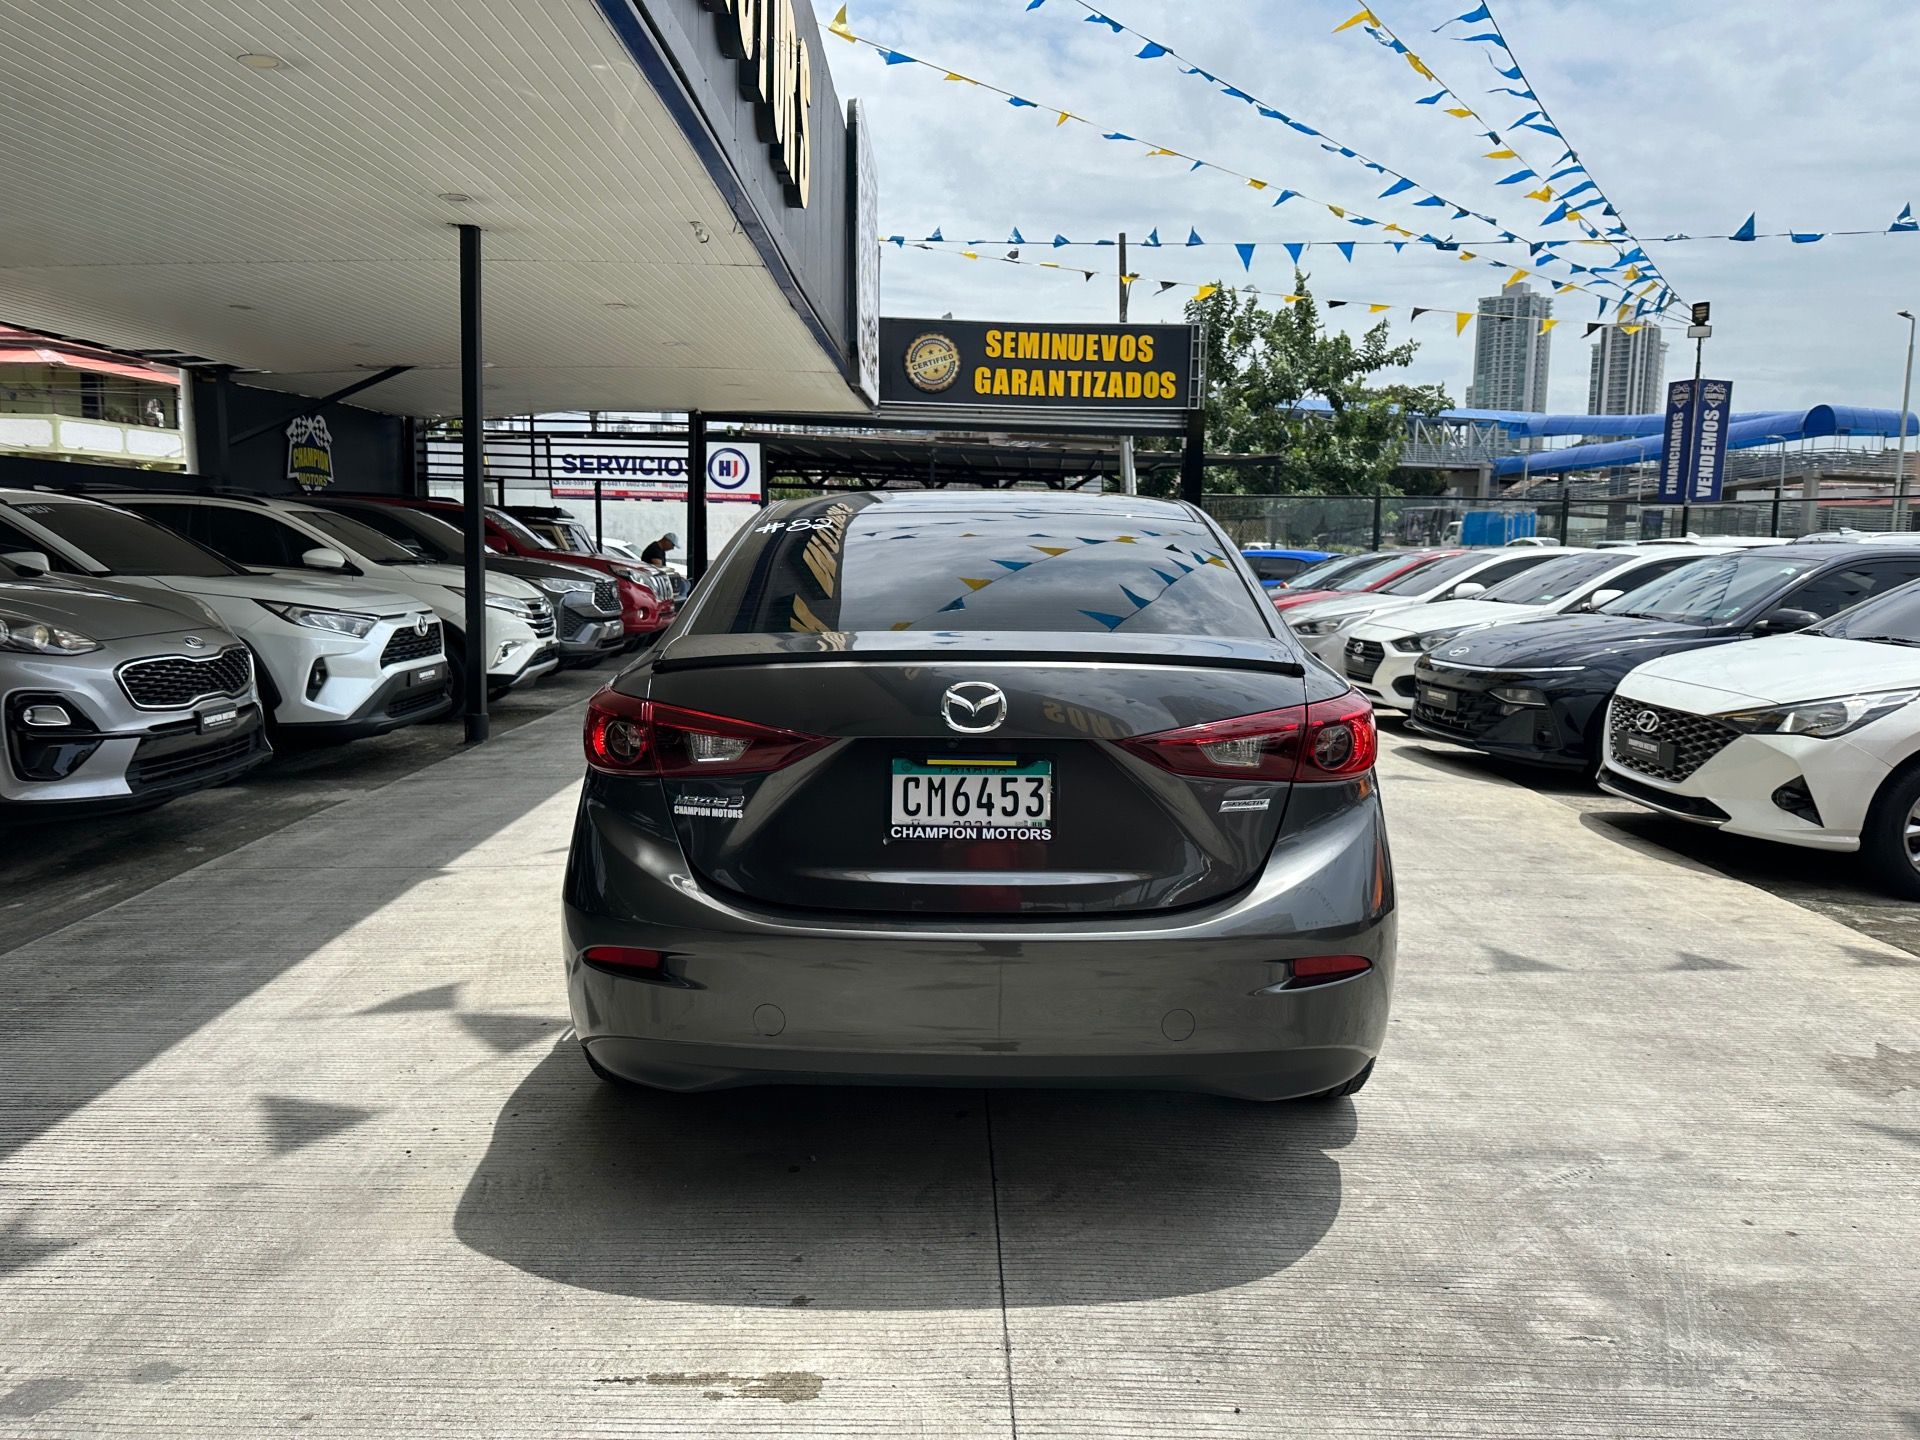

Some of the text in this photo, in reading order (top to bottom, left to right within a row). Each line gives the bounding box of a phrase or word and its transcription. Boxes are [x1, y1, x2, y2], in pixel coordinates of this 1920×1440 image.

[985, 329, 1154, 363] SEMINUEVOS
[912, 354, 954, 371] CERTIFIED
[974, 366, 1176, 399] GARANTIZADOS
[293, 447, 330, 473] CHAMPION
[562, 454, 689, 477] SERVICIO
[1665, 412, 1684, 495] FINANCIAMOS
[1696, 409, 1720, 498] VENDEMOS
[299, 472, 328, 487] MOTORS
[903, 776, 1045, 817] CM6453
[674, 805, 743, 818] CHAMPION MOTORS
[890, 826, 1052, 841] CHAMPION MOTORS
